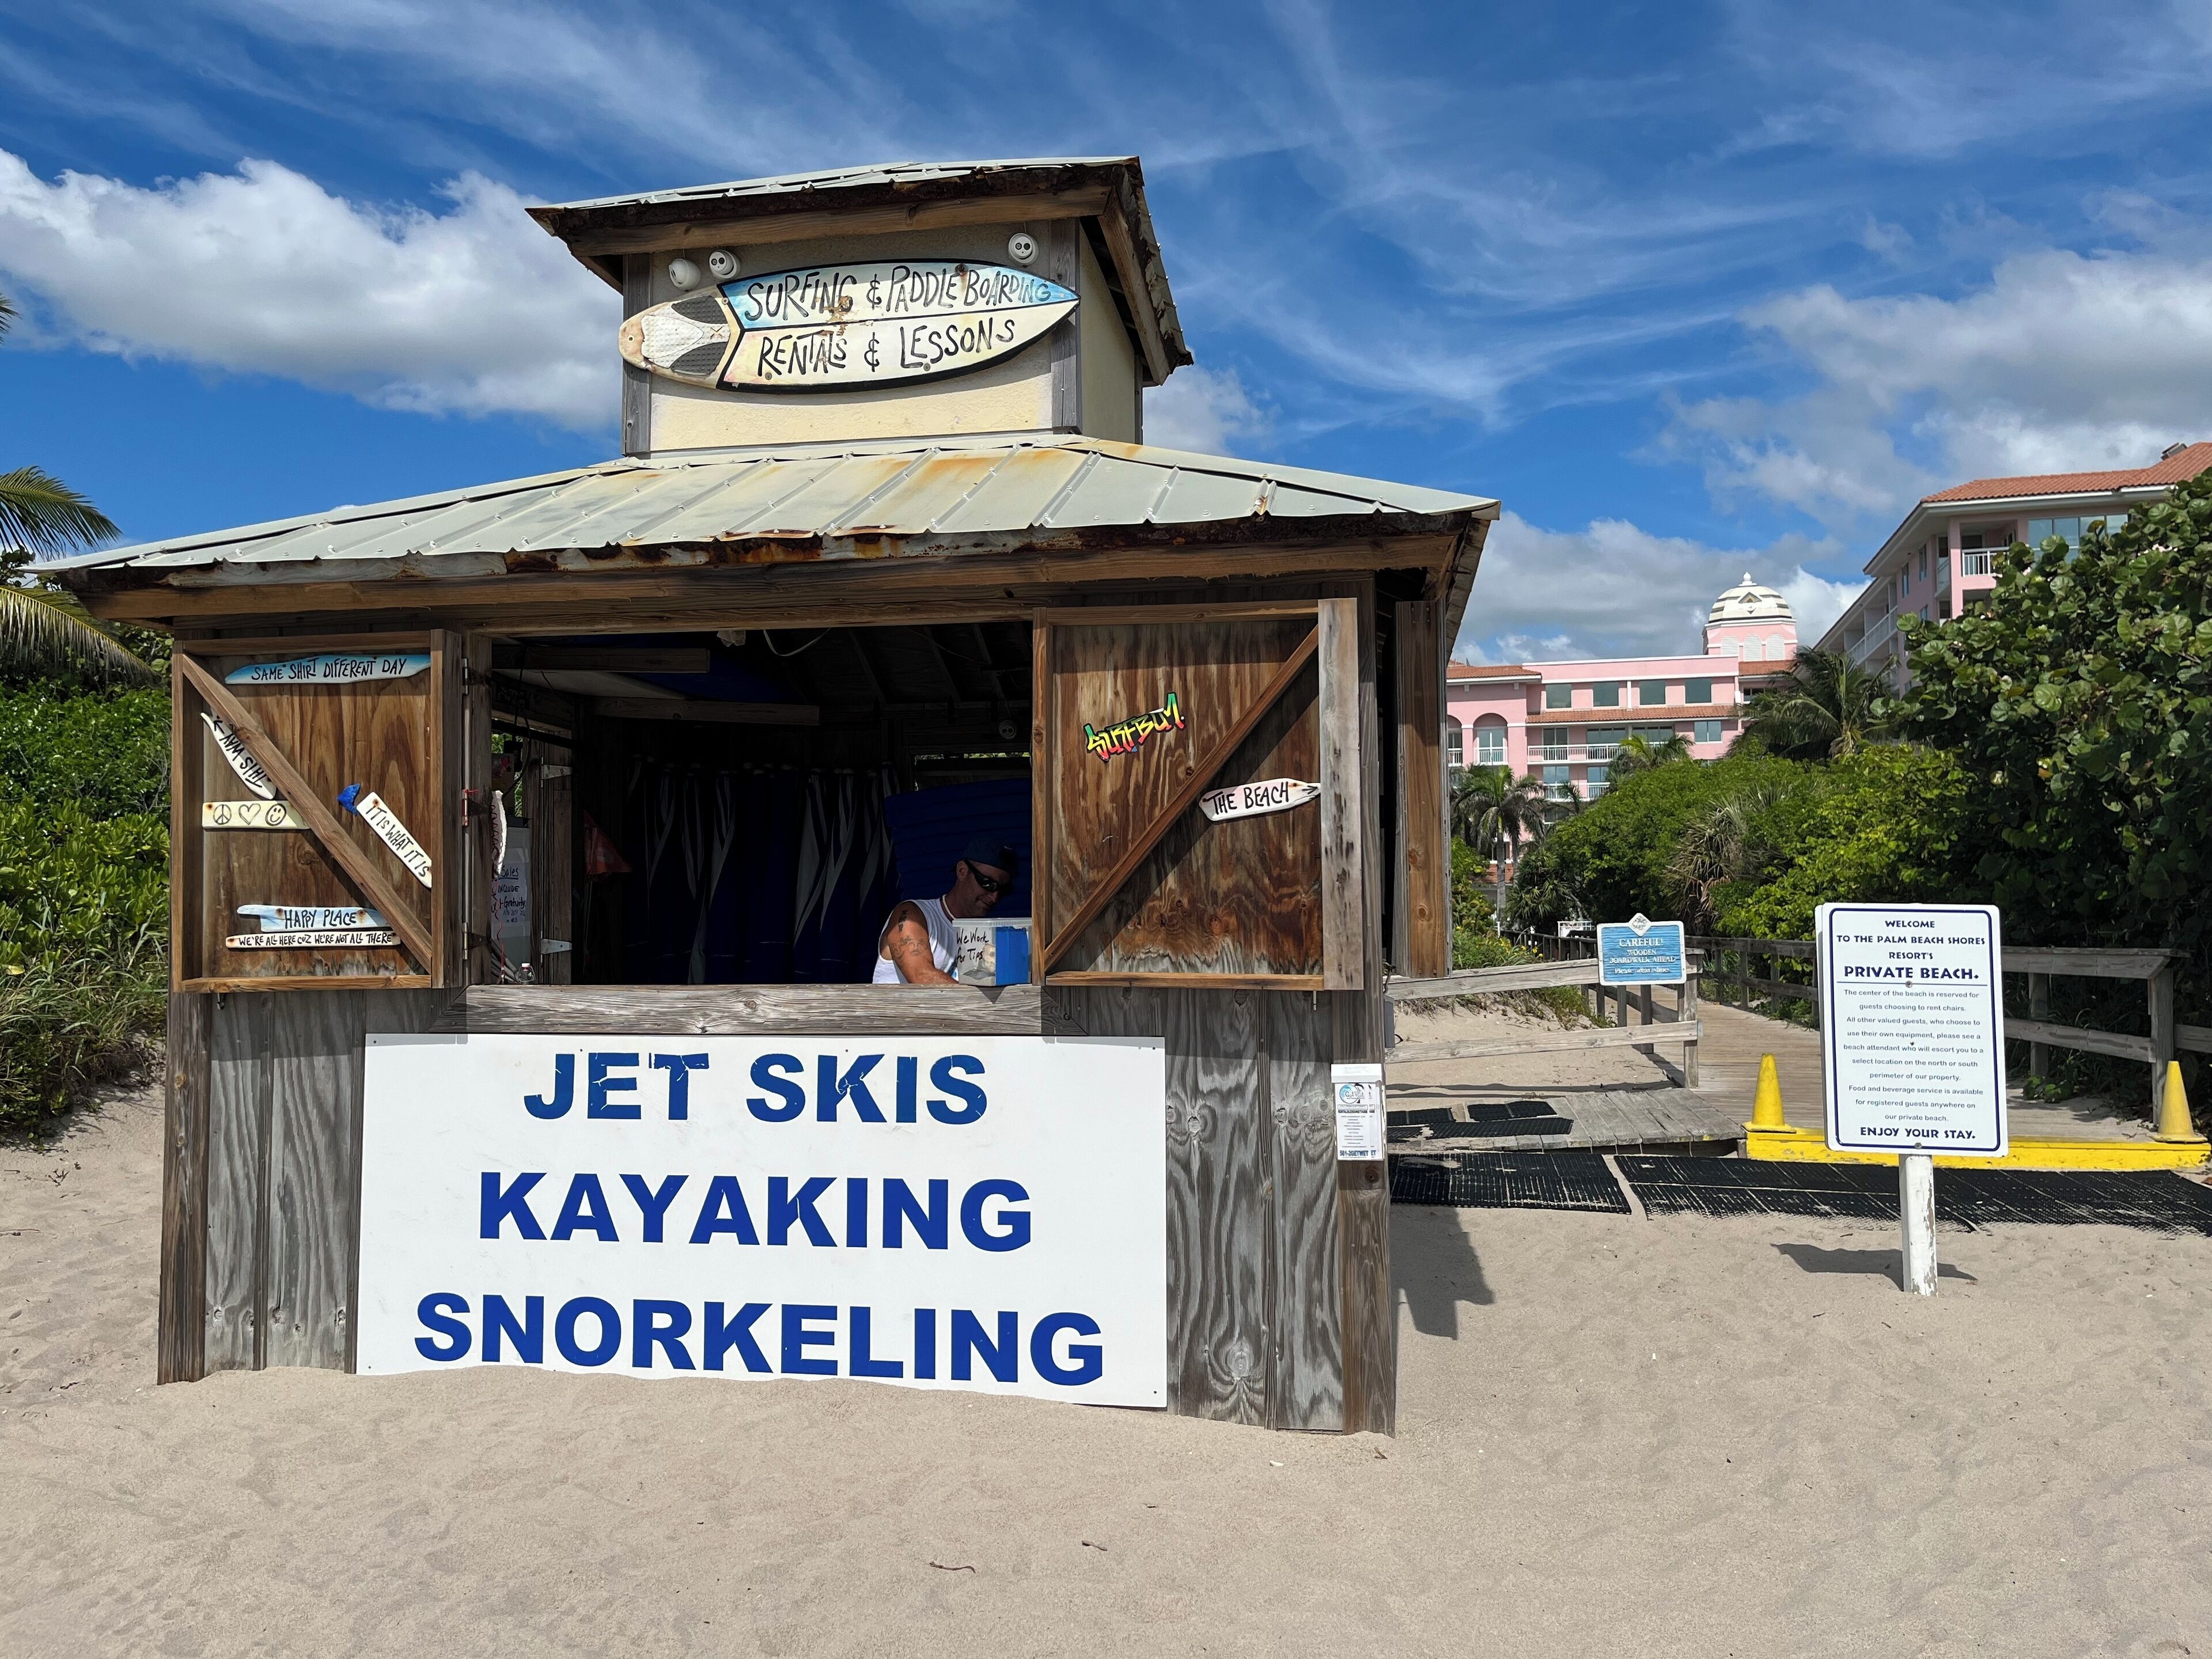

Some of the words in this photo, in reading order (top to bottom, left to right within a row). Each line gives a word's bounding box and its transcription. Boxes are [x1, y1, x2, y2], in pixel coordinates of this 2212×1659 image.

[743, 271, 857, 321] SURFING
[866, 274, 882, 309] &
[887, 264, 957, 312] PADDLE
[964, 270, 1051, 305] BOARDING
[758, 332, 847, 377] RENTALS
[864, 332, 880, 372] &
[900, 317, 1015, 370] LESSONS
[251, 666, 284, 680] SAME
[288, 657, 319, 680] SHIRT
[323, 658, 378, 678] DIFFERENT
[381, 658, 407, 675] DAY
[219, 724, 245, 762] WAY
[240, 757, 267, 787] THIS
[1210, 791, 1237, 815] THE
[1244, 782, 1289, 809] BEACH
[366, 806, 387, 820] IT
[376, 816, 389, 829] IS
[385, 824, 414, 851] WHAT
[404, 850, 424, 862] IT
[414, 861, 429, 877] IS
[501, 865, 518, 877] Sales
[498, 884, 520, 893] INCLUDE
[323, 909, 357, 927] PLACE
[238, 935, 263, 946] WE'RE
[266, 936, 278, 946] ALL
[279, 935, 296, 945] HERE
[298, 934, 312, 945] CUZ
[315, 934, 334, 944] WE'RE
[336, 934, 349, 944] NOT
[350, 934, 363, 944] ALL
[366, 933, 392, 944] THERE
[956, 928, 969, 944] We
[970, 927, 989, 944] Work
[1877, 935, 1907, 944] PALM
[956, 949, 965, 963] for
[967, 948, 983, 961] Tips
[1889, 952, 1933, 960] RESORT'S
[1844, 966, 1913, 978] PRIVATE
[1921, 967, 1979, 979] BEACH.
[525, 1053, 709, 1119] JET
[748, 1054, 986, 1124] SKIS
[1861, 1127, 1899, 1137] ENJOY
[1904, 1128, 1939, 1138] YOUR
[1944, 1130, 1975, 1139] STAY.
[481, 1172, 1030, 1252] KAYAKING
[416, 1293, 1101, 1385] SNORKELING
